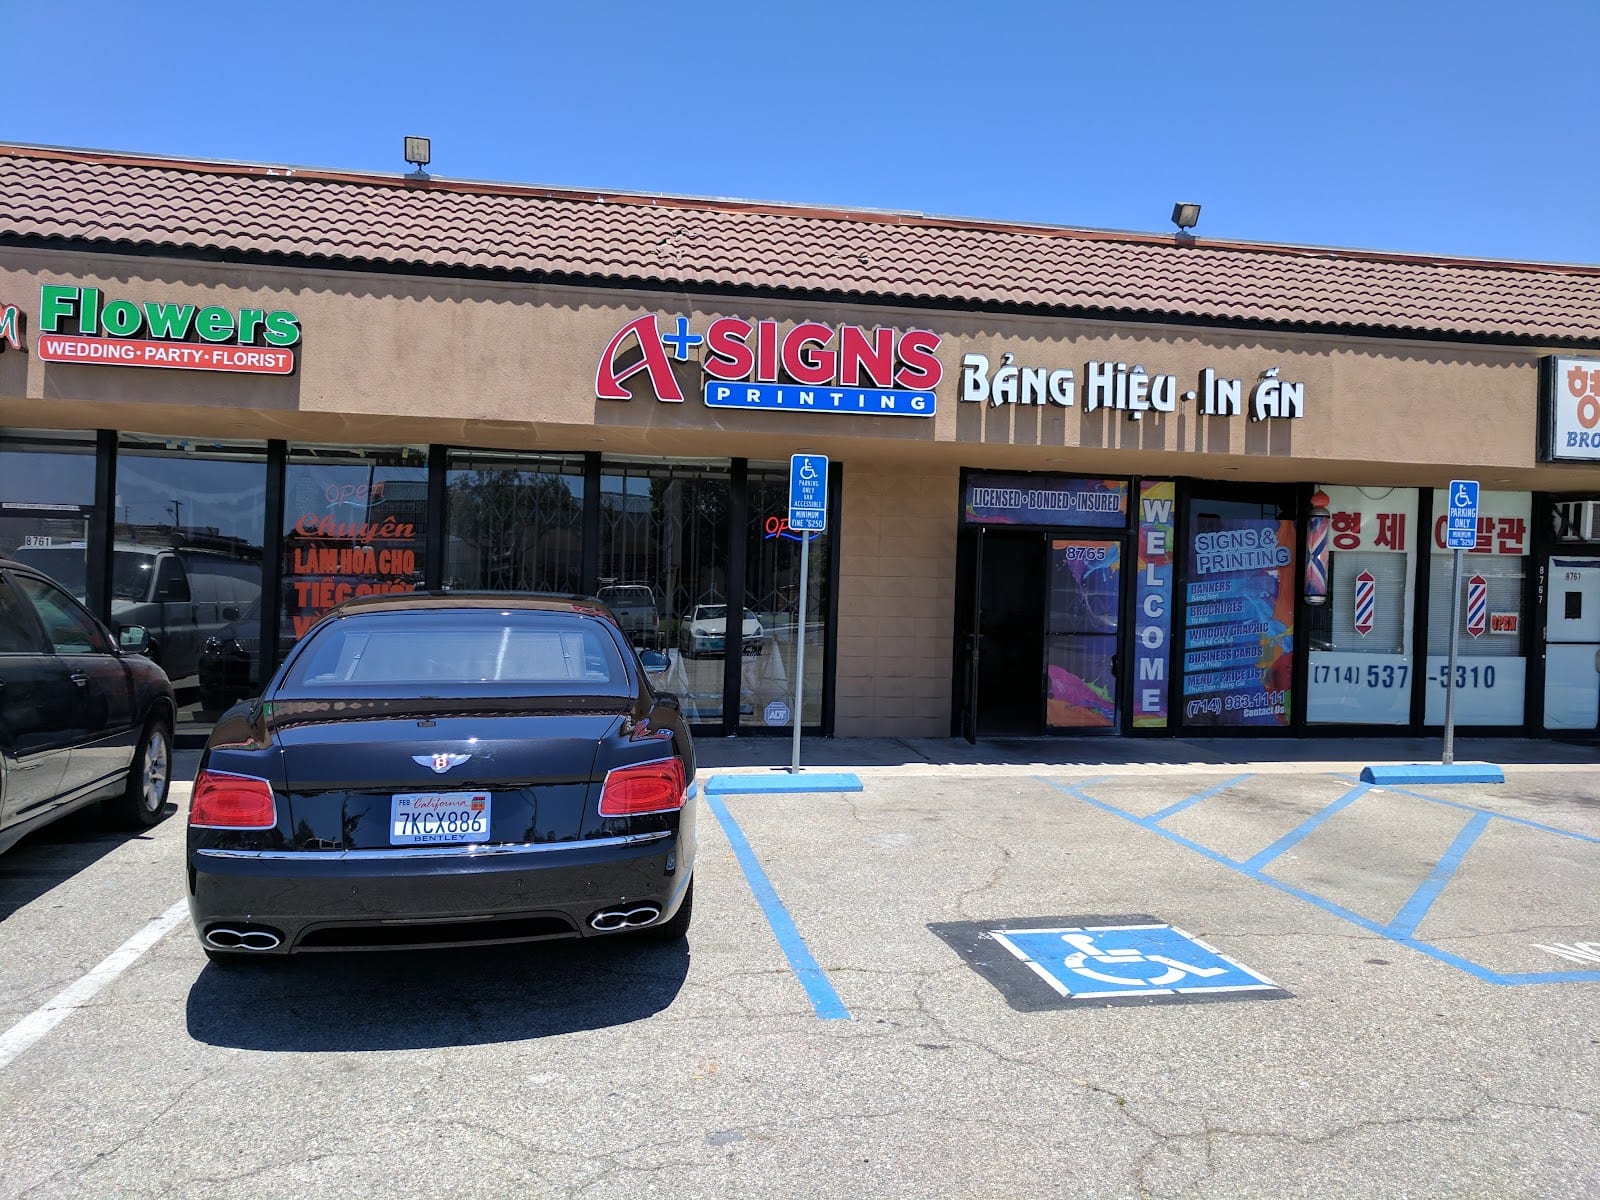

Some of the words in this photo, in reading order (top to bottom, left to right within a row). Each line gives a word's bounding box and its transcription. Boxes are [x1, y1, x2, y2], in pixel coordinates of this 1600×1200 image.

[40, 283, 301, 346] Flowers
[46, 340, 135, 361] WEDDING
[144, 347, 203, 365] PARTY
[212, 350, 287, 369] FLORIST
[703, 317, 944, 390] SIGNS
[717, 388, 926, 411] PRINTING
[973, 488, 1022, 509] LICENSED
[1028, 490, 1070, 510] BONDED
[1076, 492, 1120, 513] INSURED
[1451, 508, 1475, 518] PARKING
[1454, 518, 1470, 529] ONLY
[25, 536, 50, 547] 8761
[1195, 529, 1259, 553] SIGNS
[340, 547, 377, 574] HOA
[1066, 546, 1105, 560] 8765
[1197, 546, 1291, 574] PRINTING
[1191, 581, 1231, 595] BANNERS
[1537, 565, 1545, 604] 8767
[1139, 499, 1171, 713] WELCOME
[1190, 601, 1244, 617] BROCHURES
[1491, 614, 1517, 631] OPEN
[1190, 627, 1229, 641] WINDOW
[1188, 649, 1232, 664] BUSINESS
[1234, 646, 1264, 659] CARDS
[1367, 665, 1408, 689] 537
[768, 709, 786, 720] ADT
[1187, 697, 1222, 718] (714)
[413, 798, 467, 811] California
[399, 810, 482, 835] 7KCX886
[414, 833, 466, 842] BENTLEY
